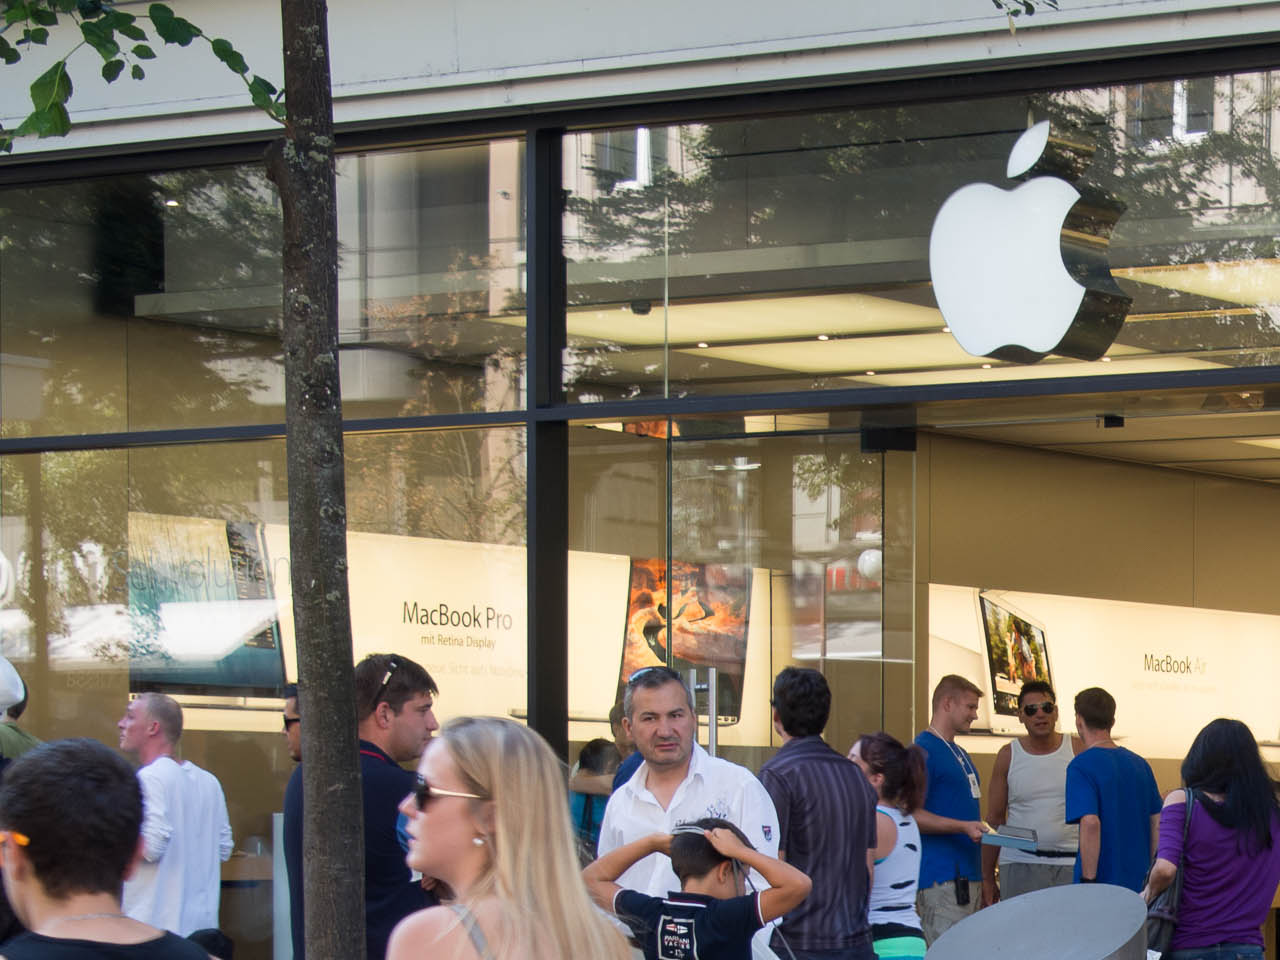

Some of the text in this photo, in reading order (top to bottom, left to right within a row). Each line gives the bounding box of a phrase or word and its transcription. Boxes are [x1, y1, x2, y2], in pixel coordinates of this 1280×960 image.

[402, 600, 513, 631] MacBook Pro
[420, 633, 497, 650] mit Retina Display
[1143, 652, 1193, 674] MacBook
